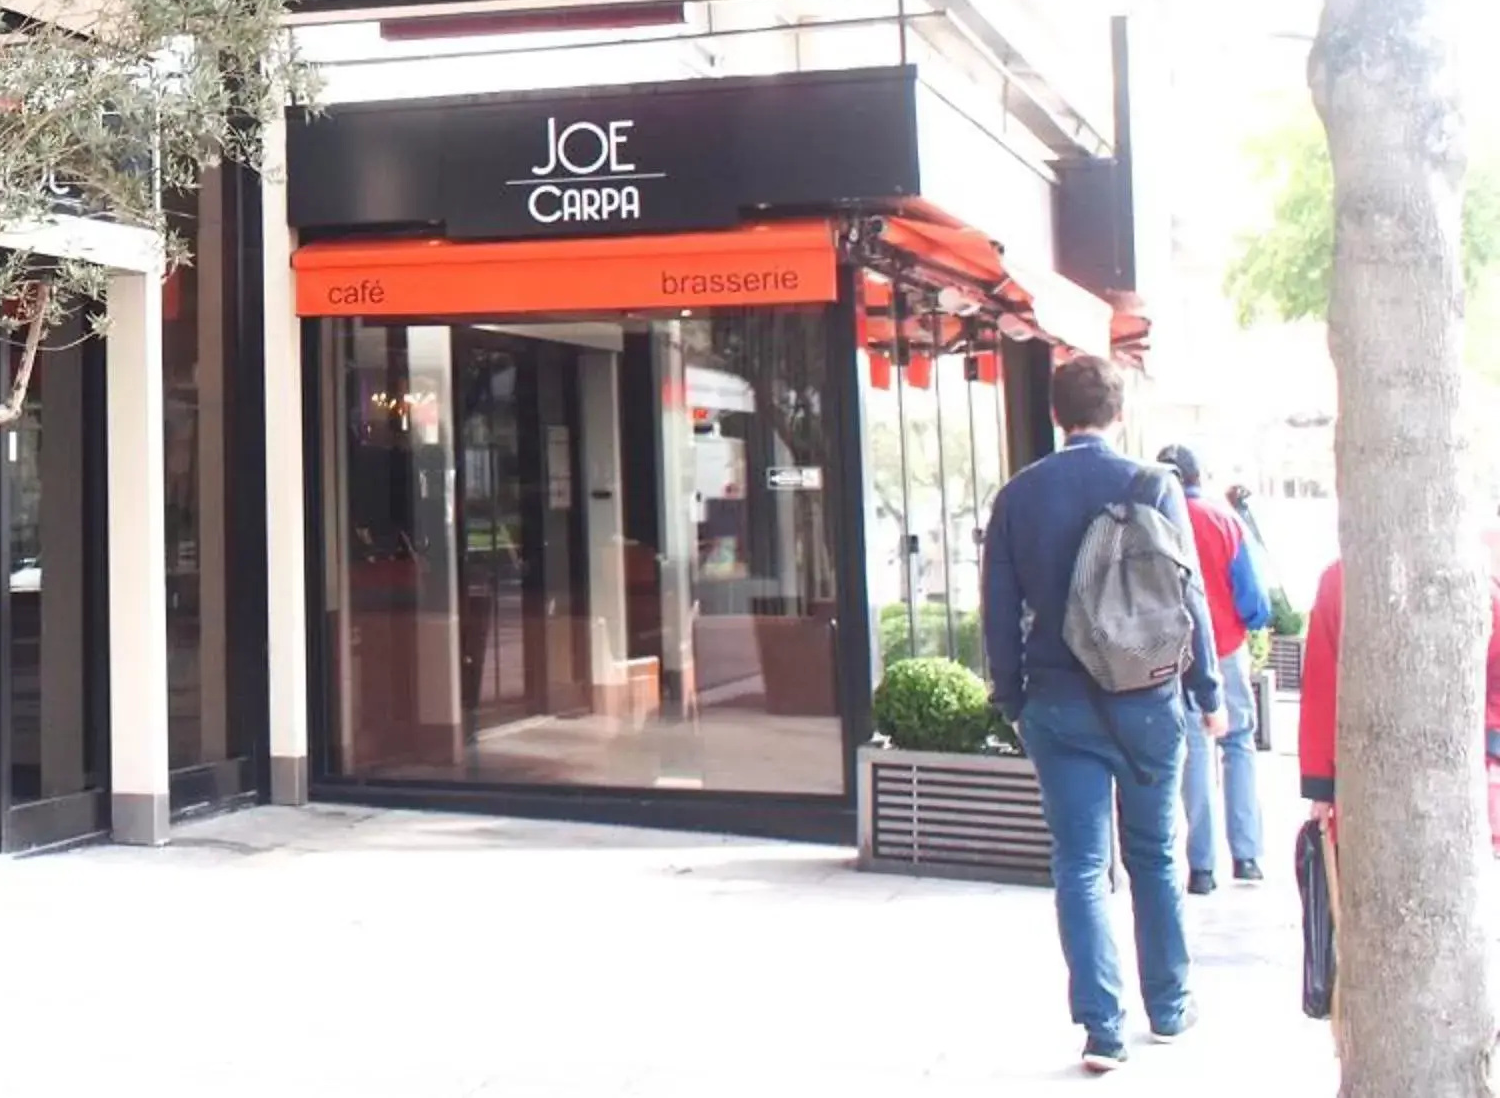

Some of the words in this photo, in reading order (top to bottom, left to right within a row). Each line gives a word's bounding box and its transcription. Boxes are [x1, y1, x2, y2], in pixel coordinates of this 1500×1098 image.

[531, 117, 636, 175] JOE
[528, 185, 640, 223] CARPA
[328, 279, 384, 304] café
[661, 266, 798, 294] brasserie
